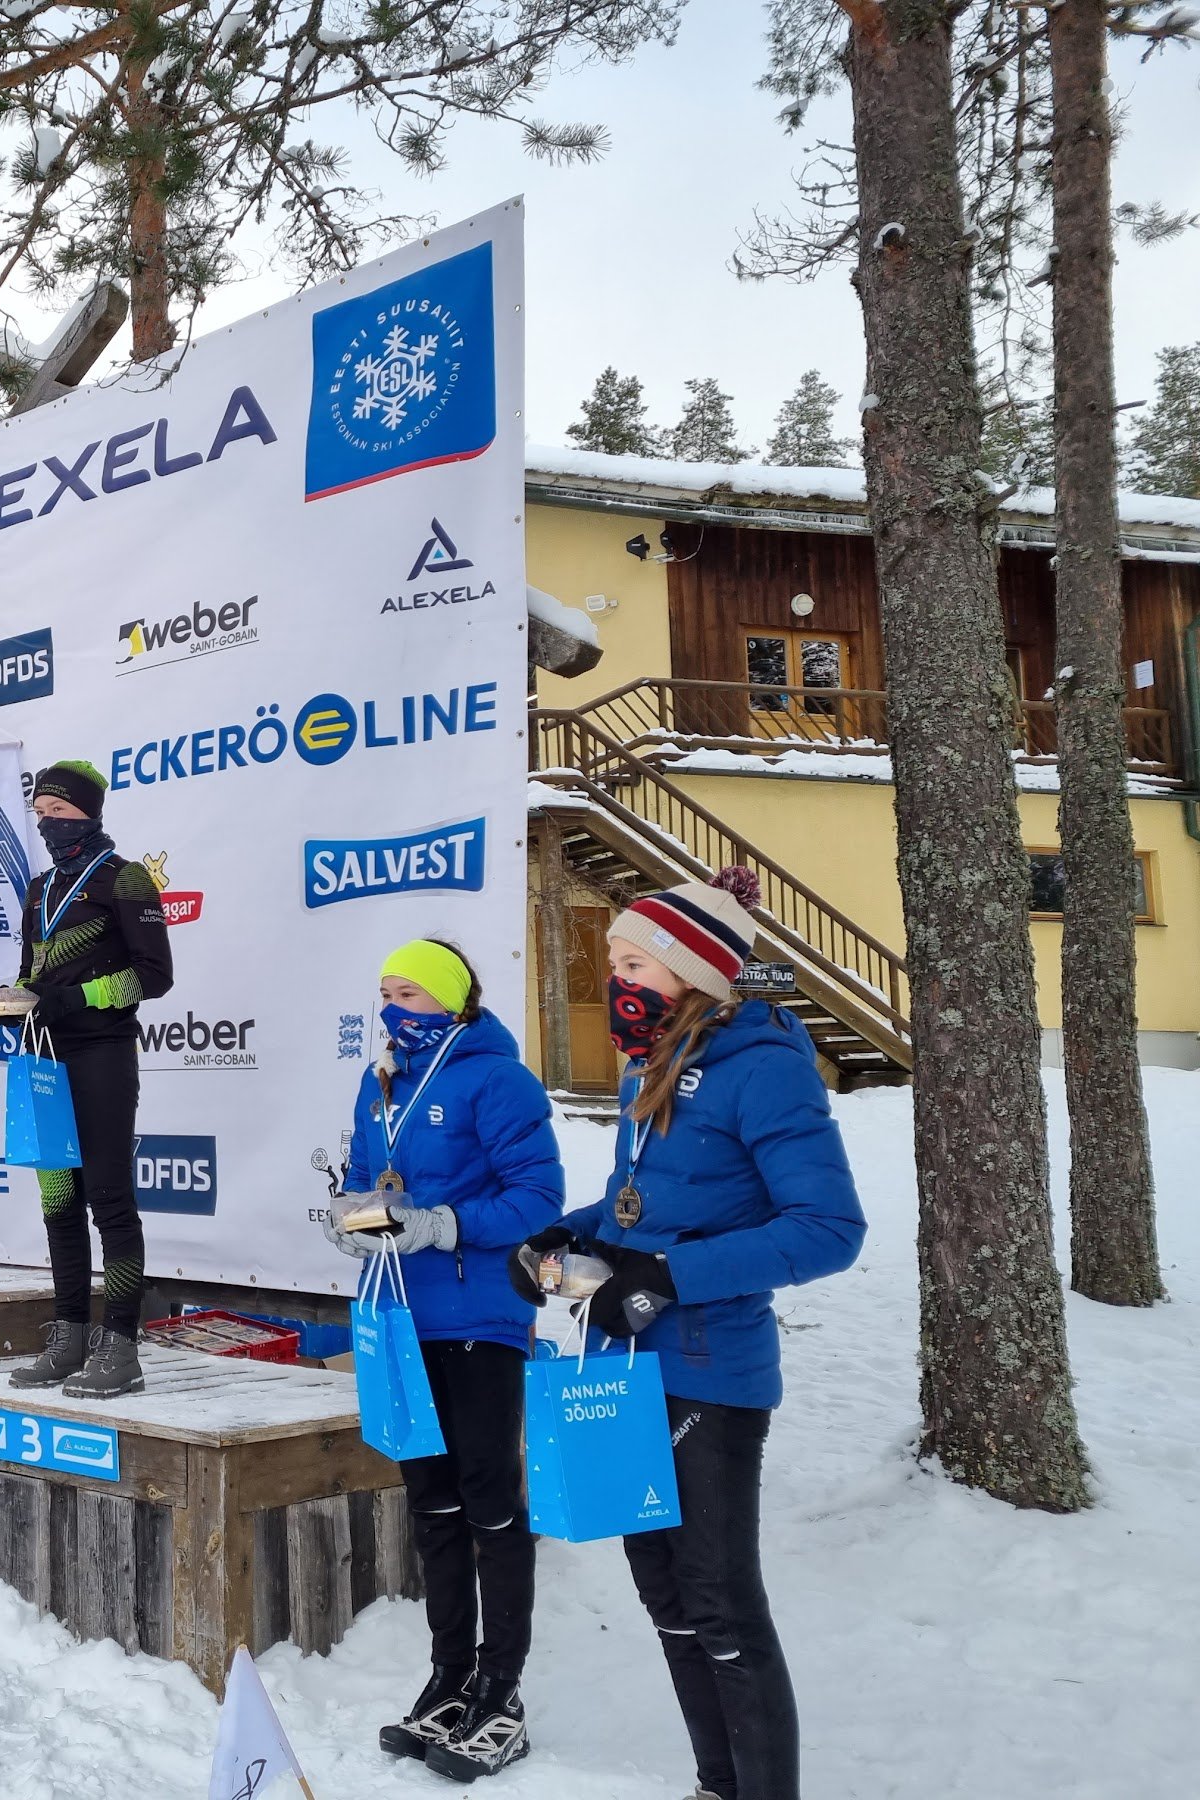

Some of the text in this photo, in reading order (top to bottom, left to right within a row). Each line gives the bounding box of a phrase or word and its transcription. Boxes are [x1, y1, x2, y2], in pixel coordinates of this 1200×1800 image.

[330, 299, 464, 394] EESTI SUUSALIIT
[380, 361, 411, 398] ESL
[331, 361, 461, 452] ESTONIAN SKI ASSOCIATION
[380, 580, 496, 614] ALEXELA
[143, 595, 259, 652] weber
[189, 627, 258, 655] SAINT-GOBAIN
[110, 703, 288, 791] ECKERÖ
[364, 682, 497, 748] LINE
[312, 831, 475, 896] SALVEST
[162, 900, 196, 922] agar
[735, 970, 768, 981] ISTRA
[139, 1011, 256, 1053] weber
[184, 1053, 256, 1066] SAINT-GOBAIN
[137, 1158, 211, 1192] DFDS
[561, 1380, 629, 1401] ANNAME
[564, 1403, 618, 1423] JÕUDU
[21, 1417, 43, 1463] 3
[638, 1509, 670, 1519] ALEXELA
